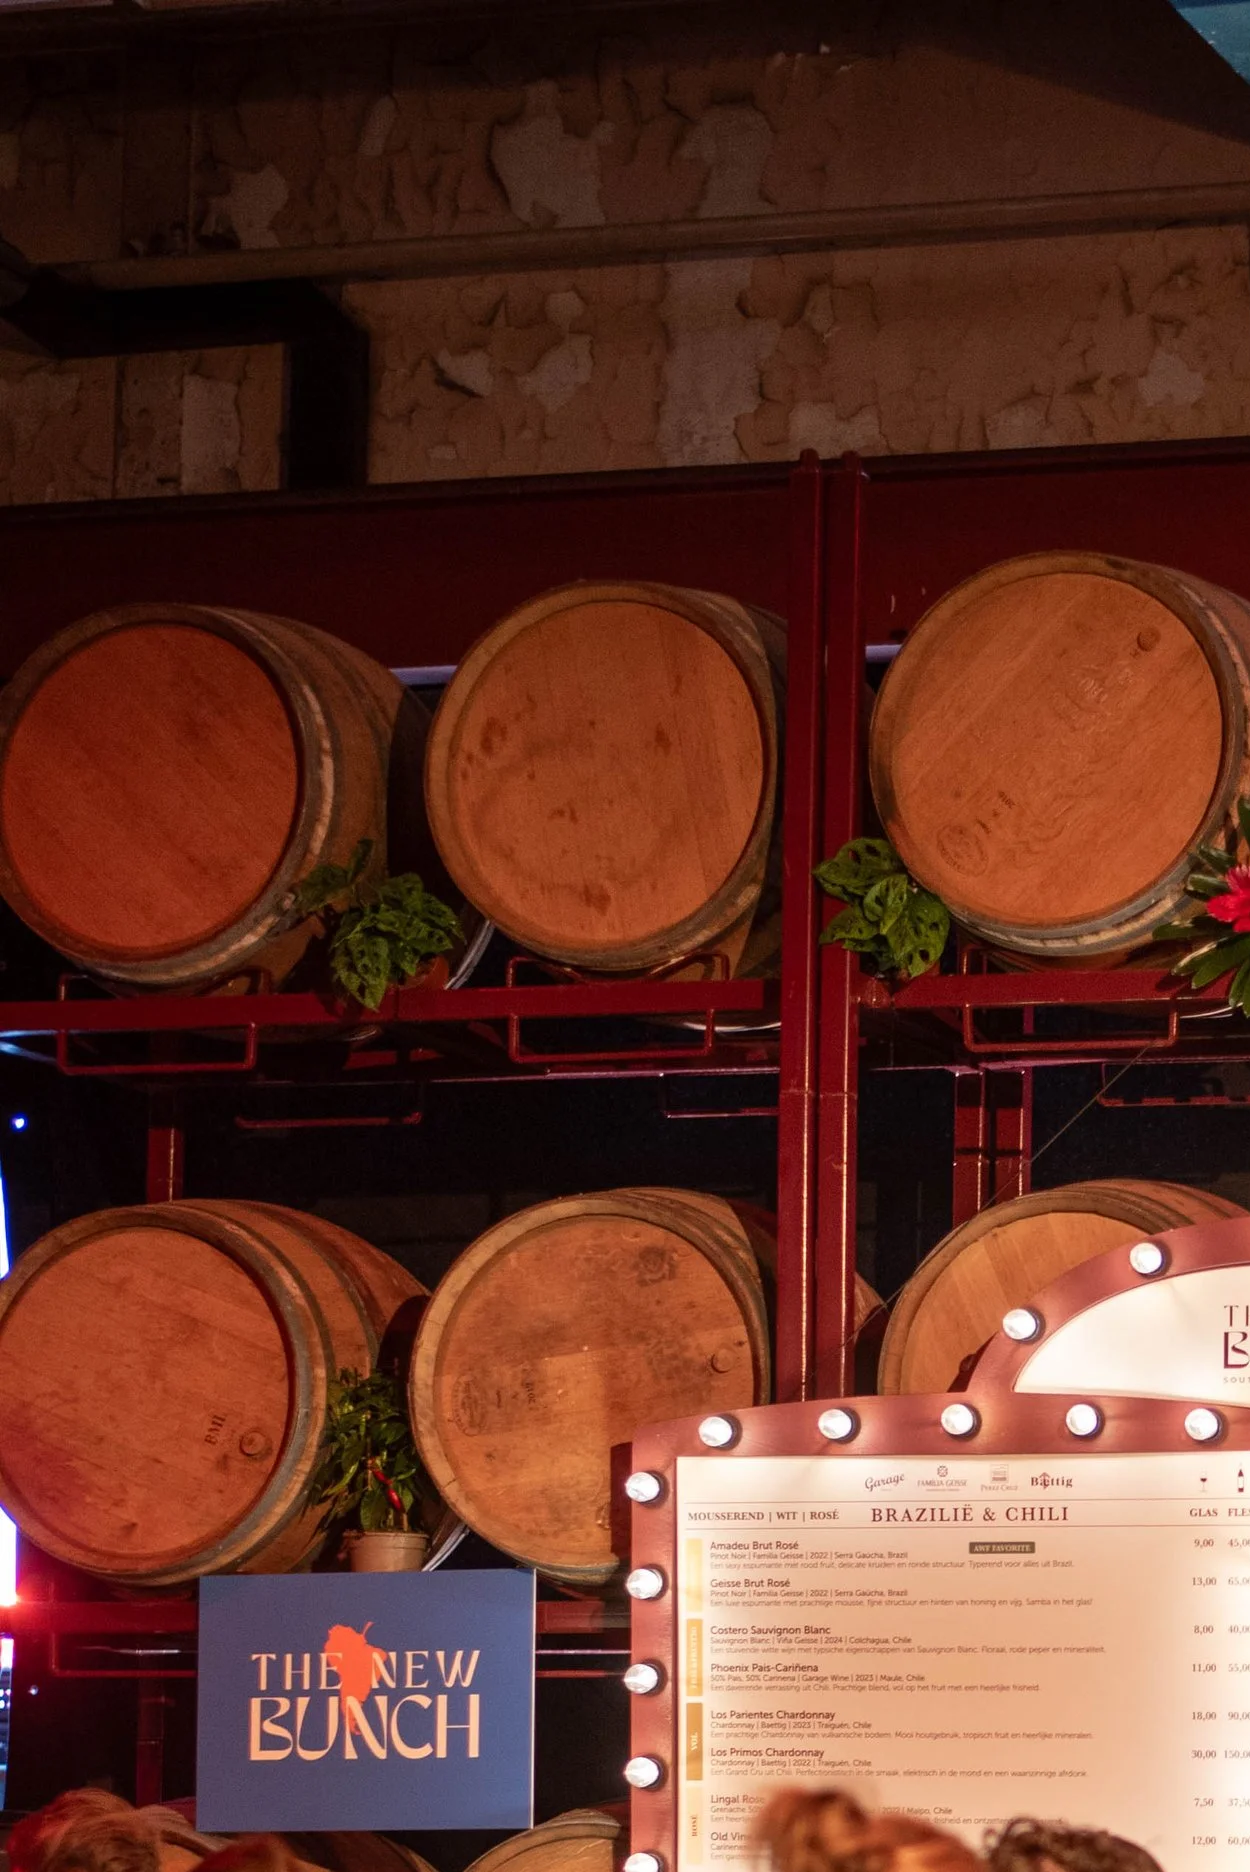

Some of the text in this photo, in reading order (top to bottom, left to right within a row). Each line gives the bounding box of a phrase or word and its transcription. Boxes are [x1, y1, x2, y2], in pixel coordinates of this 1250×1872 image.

[865, 1472, 905, 1492] Garage
[688, 1510, 839, 1521] MOUSSEREND WIT ROSÉ
[871, 1504, 1069, 1522] BRAZILIË & CHILI
[1189, 1508, 1218, 1517] GLAS
[710, 1540, 799, 1550] Amadeu Brut Rosé
[1194, 1539, 1214, 1548] 9,00
[888, 1551, 908, 1559] Brazil
[710, 1578, 790, 1588] Geisse Brut Rosé
[1192, 1577, 1217, 1586] 13,00
[710, 1626, 831, 1637] Costero Sauvignon Blanc
[1194, 1625, 1213, 1634] 8,00
[252, 1650, 481, 1691] THE NEW
[710, 1664, 749, 1673] Phoenix
[1192, 1664, 1217, 1673] 11,00
[710, 1711, 836, 1721] Los Parientes Chardonnay
[1192, 1712, 1217, 1721] 18,00
[250, 1694, 480, 1761] BUNCH
[710, 1722, 755, 1730] Chardonnay
[710, 1748, 824, 1759] Los Primos Chardonnay
[1191, 1750, 1217, 1759] 30,00
[710, 1795, 740, 1805] Lingal
[1194, 1798, 1213, 1807] 7,50
[710, 1832, 749, 1841] Old Vin
[1191, 1836, 1216, 1845] 12,00
